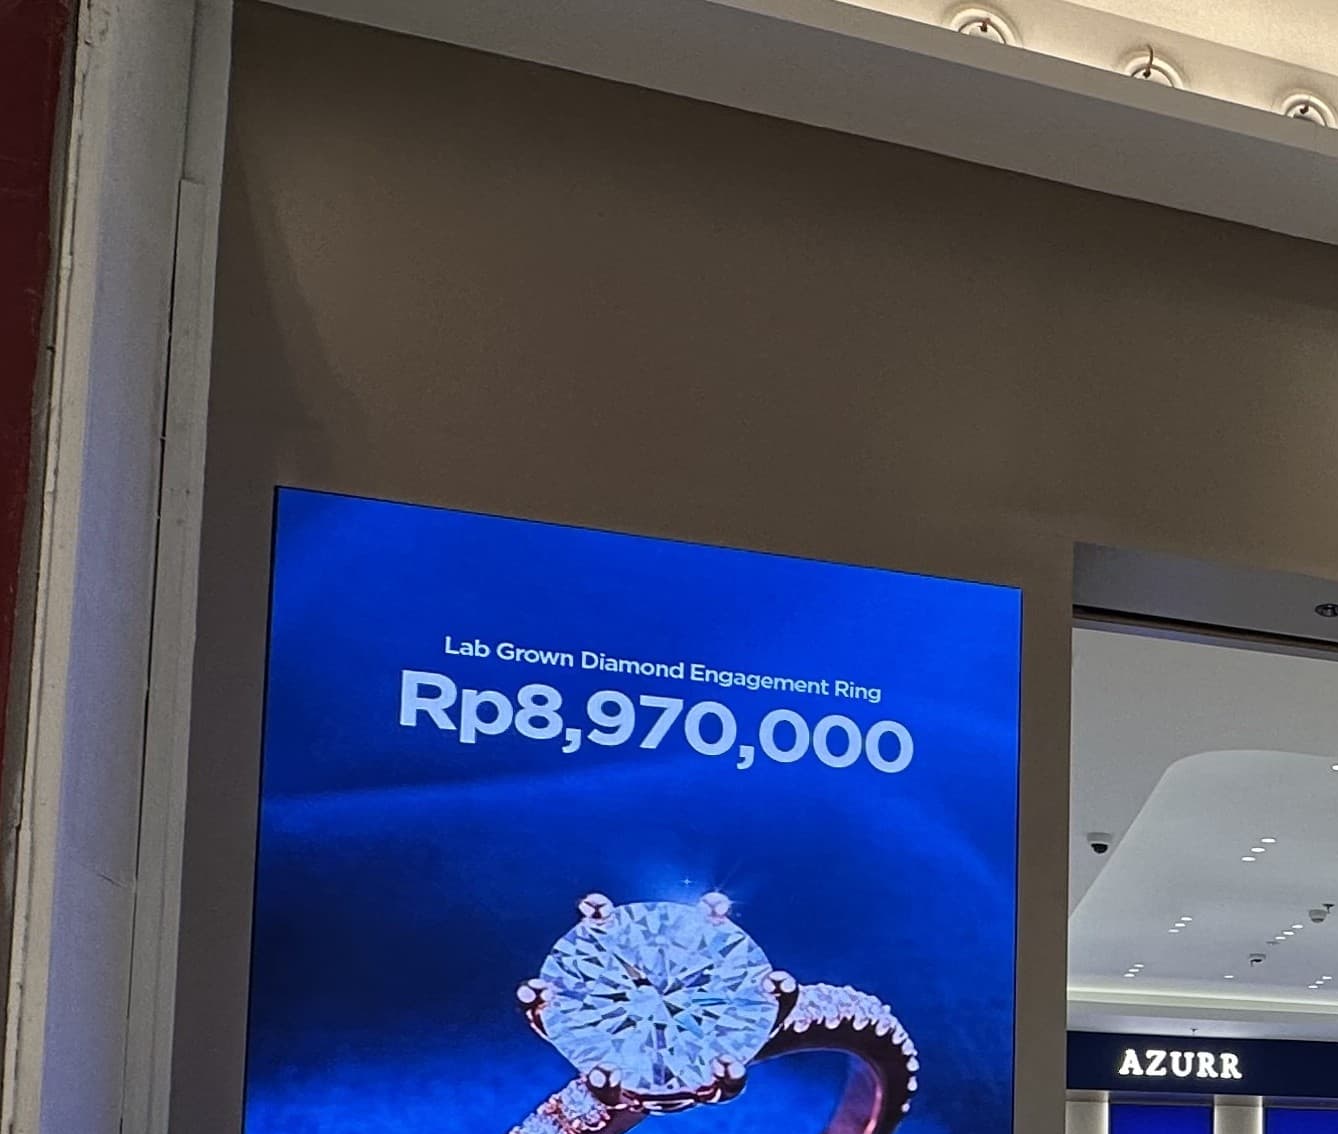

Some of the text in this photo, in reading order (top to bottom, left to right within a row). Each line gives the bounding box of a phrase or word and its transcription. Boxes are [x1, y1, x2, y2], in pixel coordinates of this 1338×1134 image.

[444, 636, 882, 704] Lab Grown Diamond Engagement Ring
[399, 669, 915, 774] Rp8,970,000
[1118, 1048, 1243, 1079] AZURR
